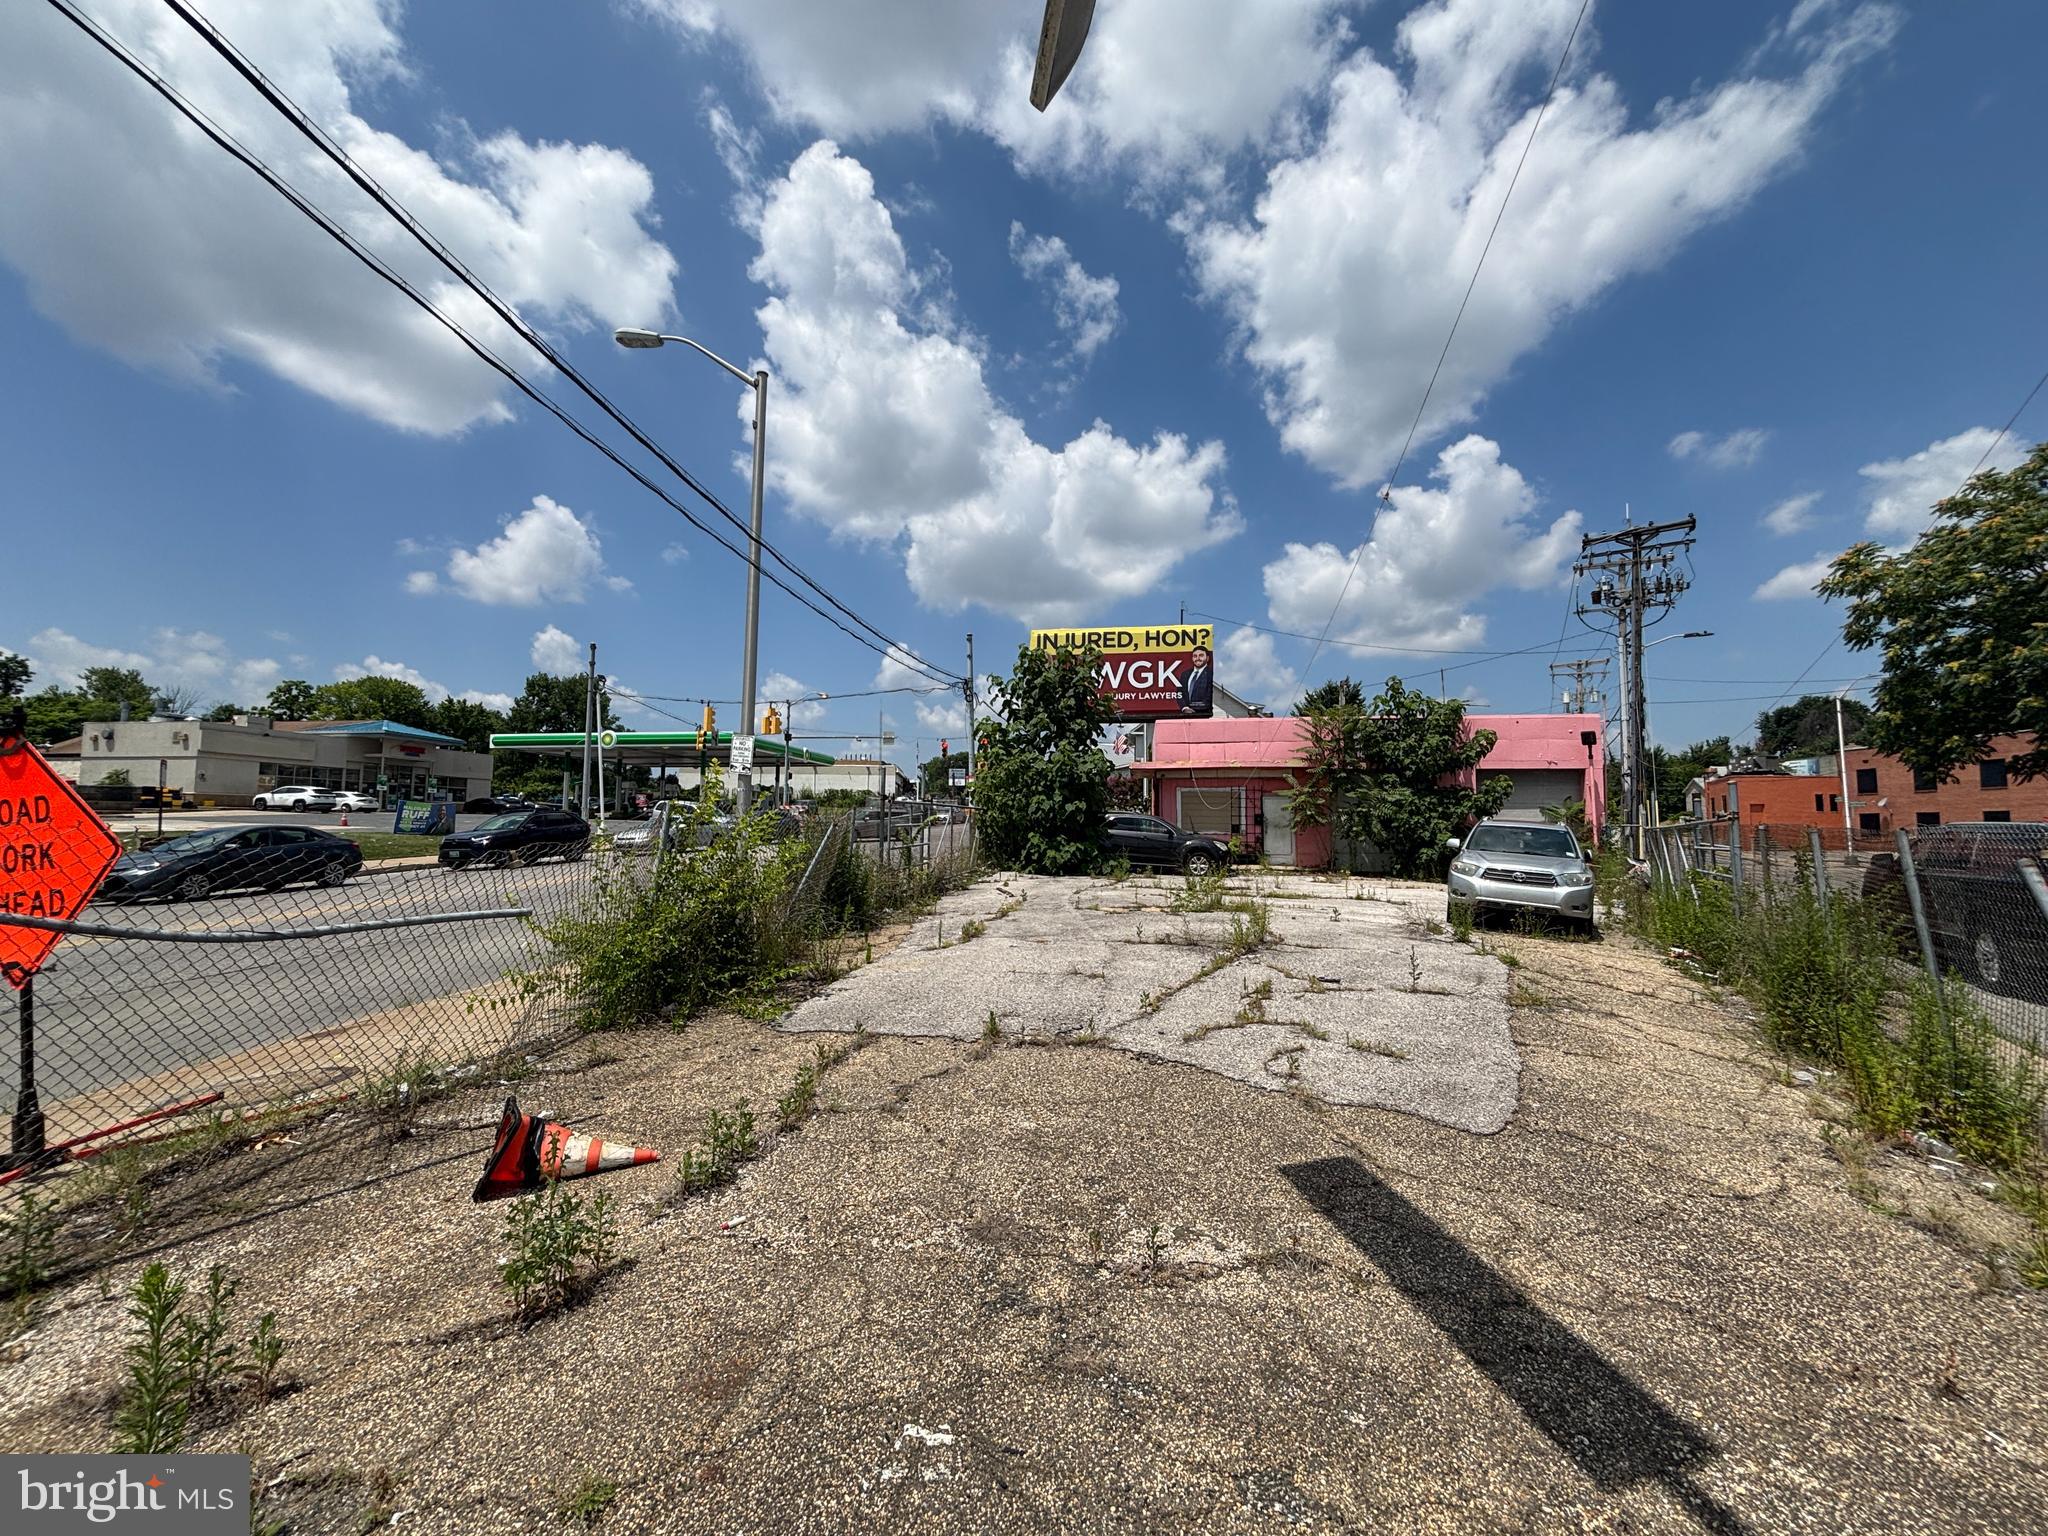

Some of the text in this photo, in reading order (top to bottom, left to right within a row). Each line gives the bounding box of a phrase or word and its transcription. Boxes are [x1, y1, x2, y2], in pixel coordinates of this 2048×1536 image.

[1036, 628, 1210, 651] INJURED, HON?
[1091, 660, 1182, 689] WGK
[1104, 692, 1136, 700] JURY
[1139, 692, 1183, 700] LAWYERS
[0, 795, 51, 826] OAD
[401, 810, 430, 819] RUFF
[3, 842, 56, 873] ORK
